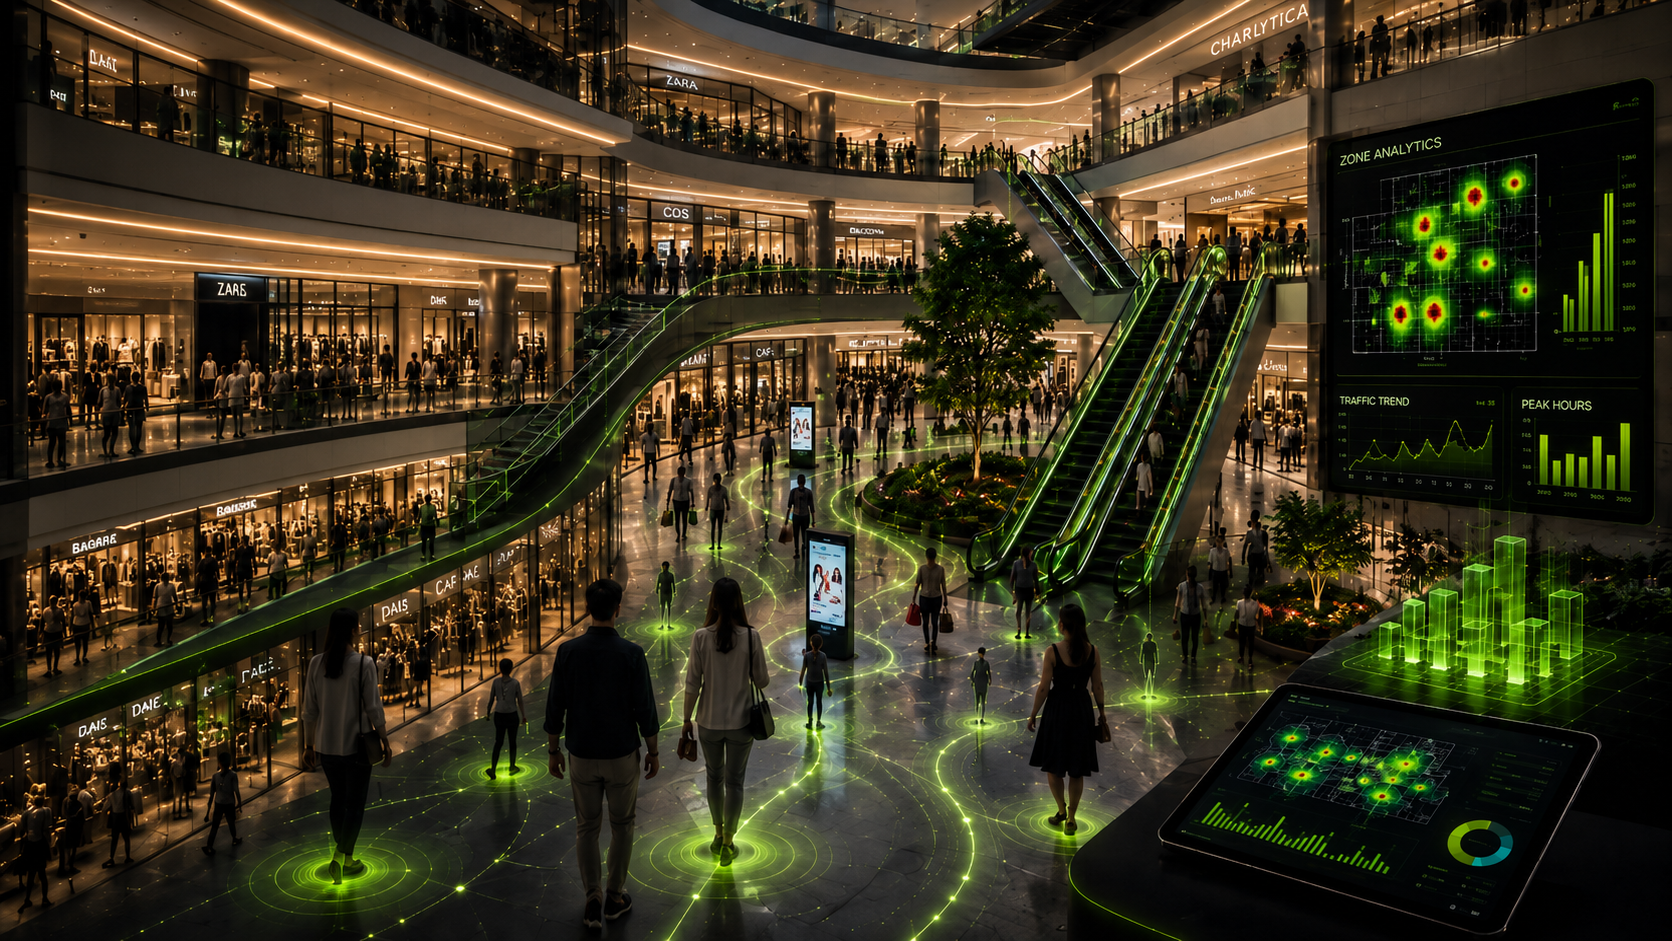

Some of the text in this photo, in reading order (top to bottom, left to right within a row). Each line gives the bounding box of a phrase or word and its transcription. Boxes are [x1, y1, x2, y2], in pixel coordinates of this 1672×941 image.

[1210, 3, 1310, 56] CHARLYTICA
[666, 74, 699, 91] ZARA
[1339, 136, 1442, 166] ZONE ANALYTICS
[662, 206, 690, 220] COS
[1339, 395, 1410, 408] TRAFFIC TREND
[1521, 399, 1593, 412] PEAK HOURS
